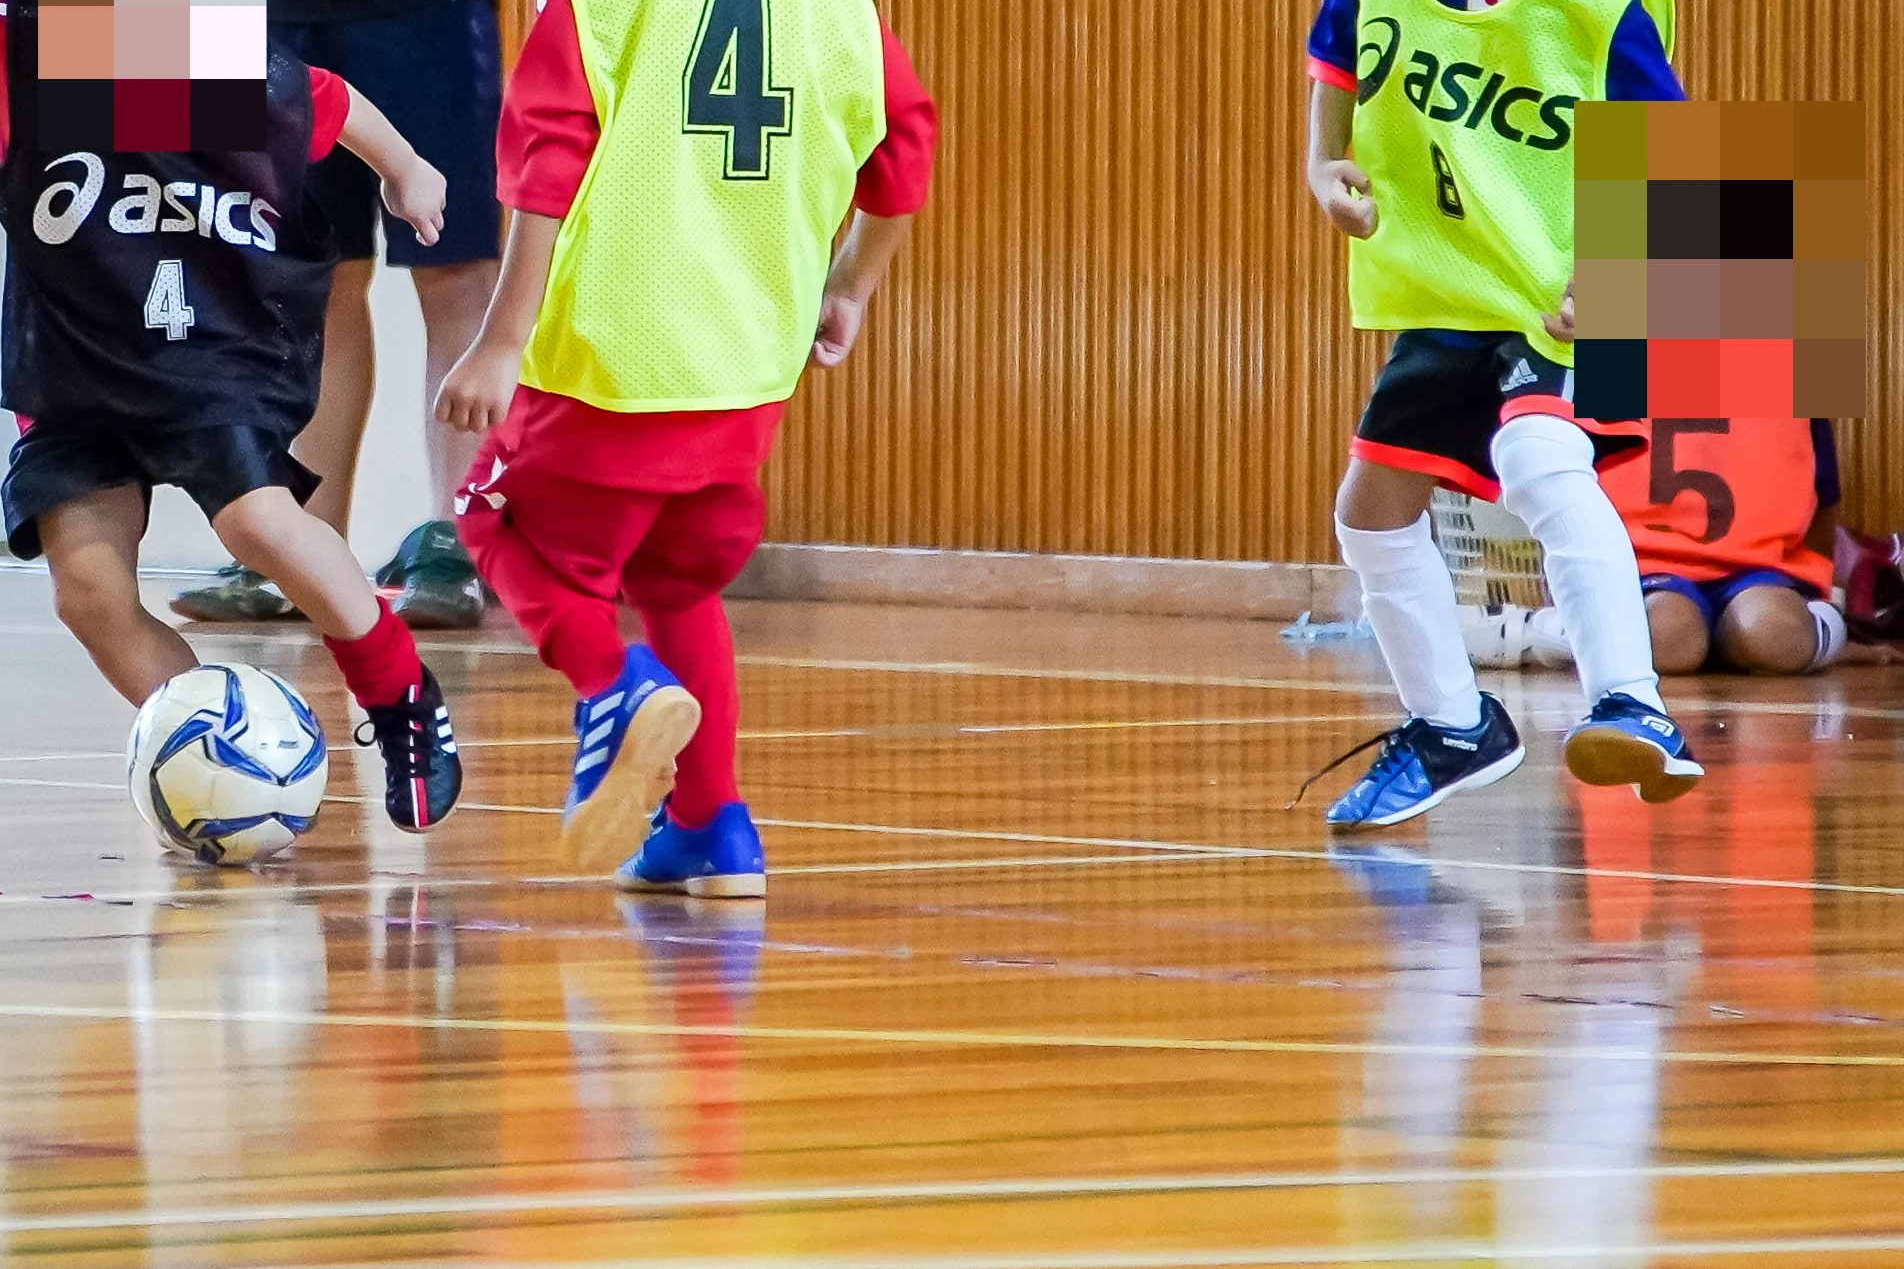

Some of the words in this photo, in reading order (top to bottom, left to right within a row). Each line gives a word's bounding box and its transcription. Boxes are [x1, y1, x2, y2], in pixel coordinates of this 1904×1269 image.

[1404, 49, 1580, 151] asics
[108, 173, 282, 252] asics
[144, 259, 195, 341] 4
[1649, 418, 1735, 544] 5
